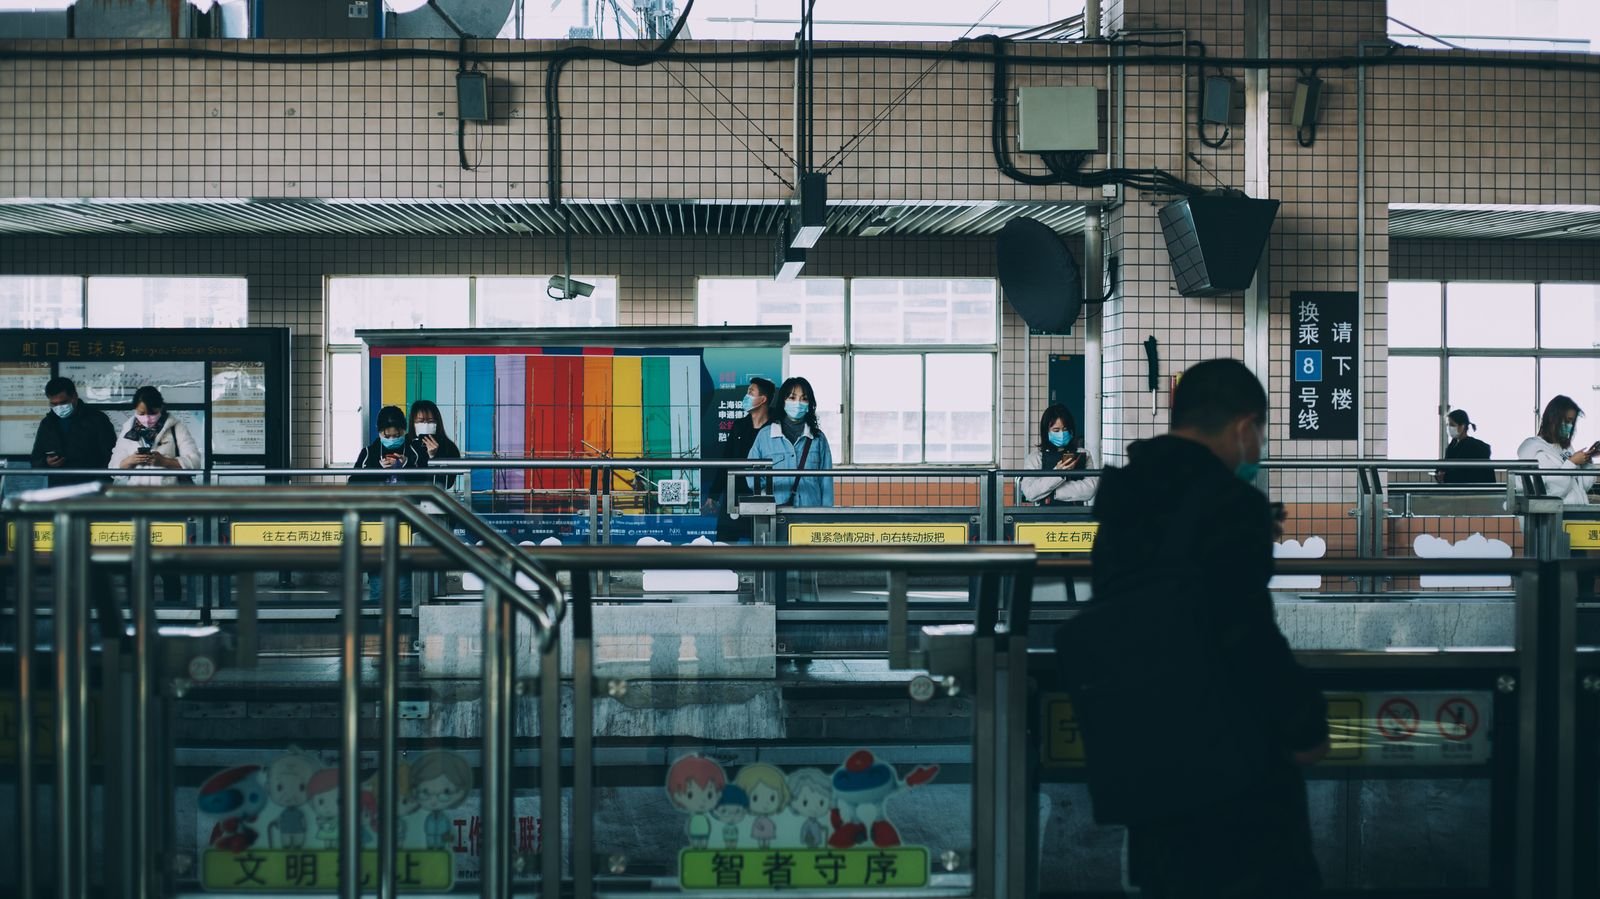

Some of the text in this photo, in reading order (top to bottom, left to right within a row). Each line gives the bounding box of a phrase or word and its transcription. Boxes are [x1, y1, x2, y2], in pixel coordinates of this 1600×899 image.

[22, 340, 126, 357] 虹口足球场
[1331, 322, 1353, 411] 请下楼
[711, 851, 898, 887] 智者守序
